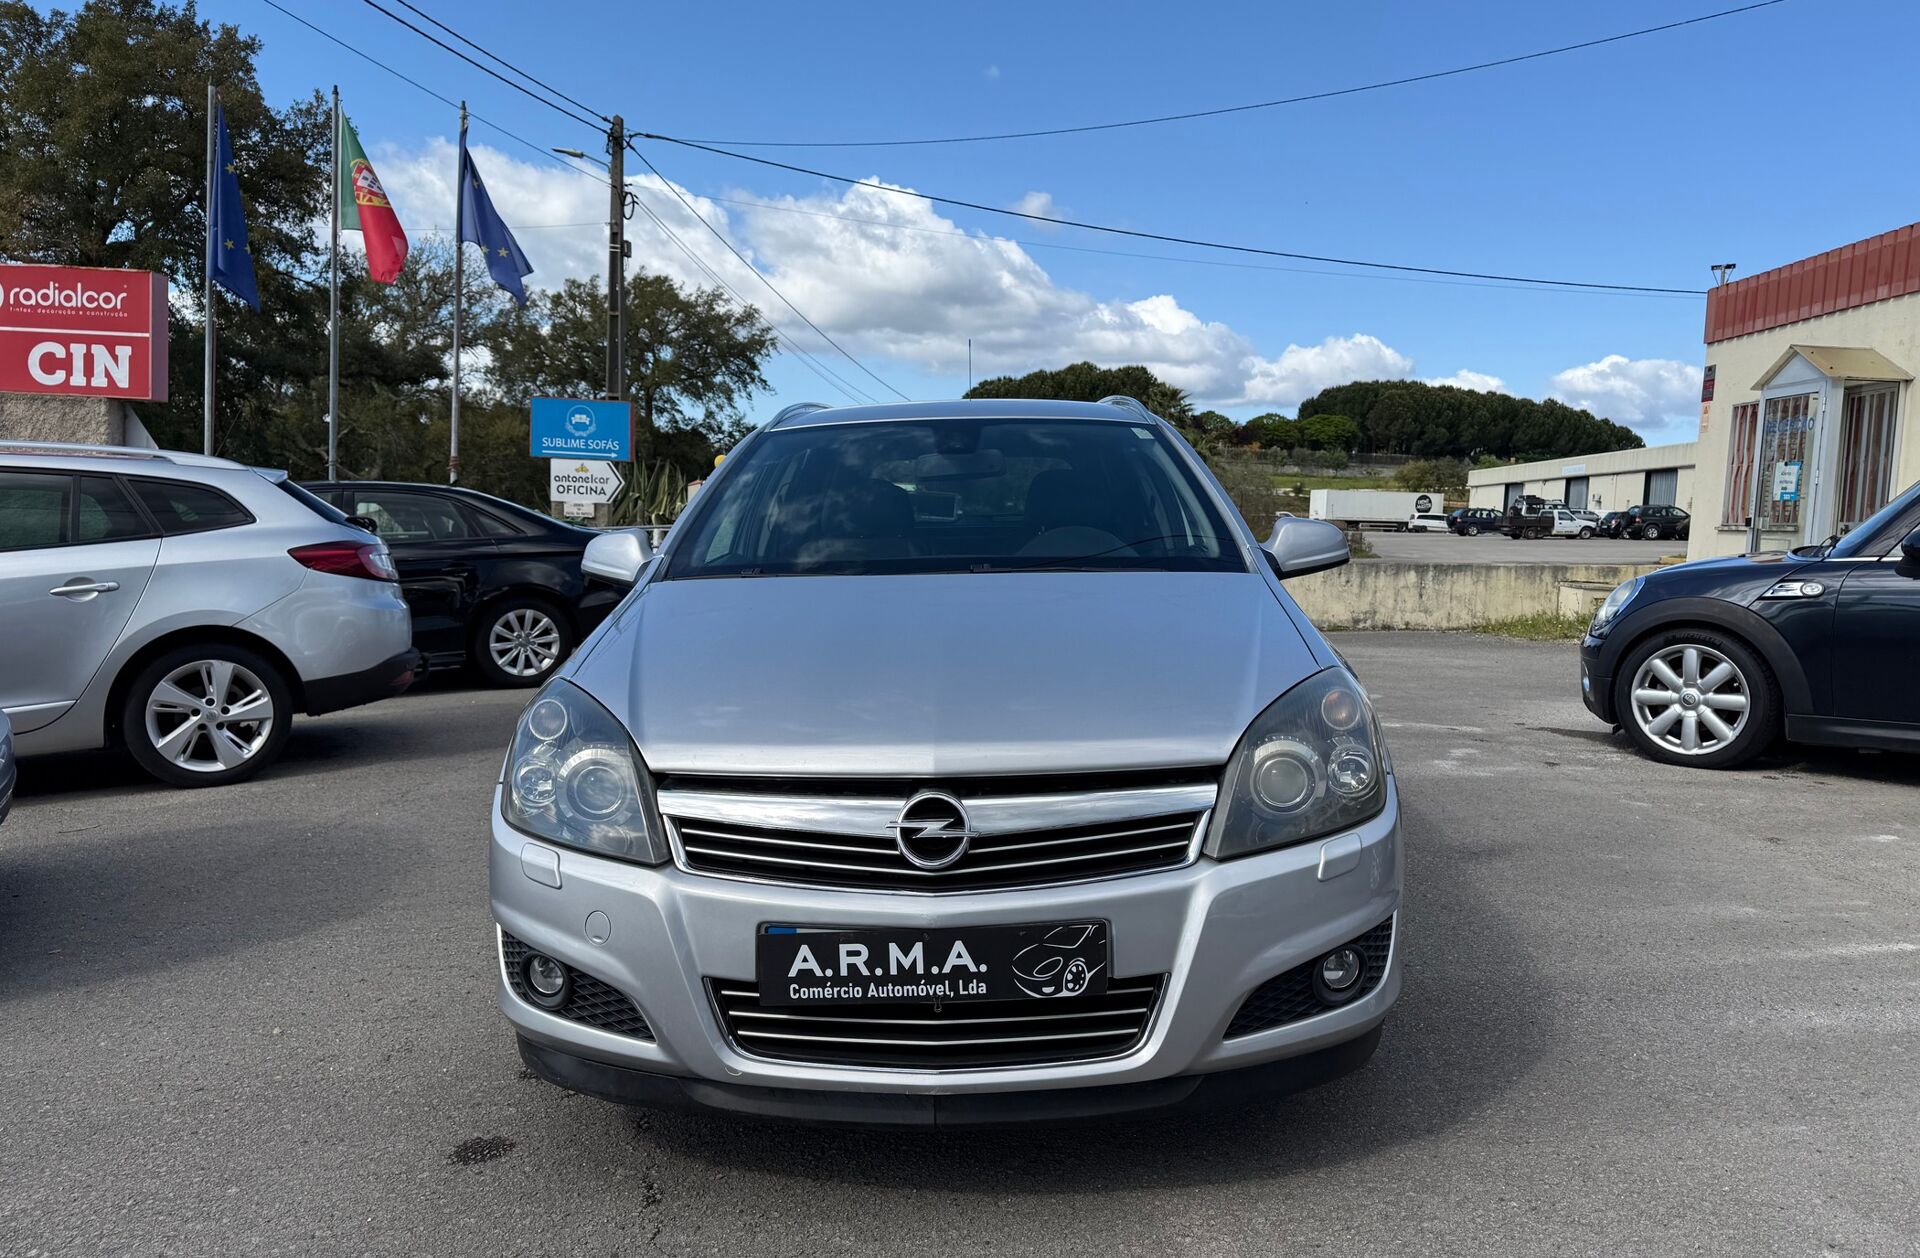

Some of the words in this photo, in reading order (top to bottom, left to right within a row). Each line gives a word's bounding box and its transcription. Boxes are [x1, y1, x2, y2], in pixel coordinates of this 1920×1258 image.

[10, 281, 127, 309] radialcor
[28, 341, 132, 388] CIN
[542, 437, 586, 449] SUBLIME
[587, 439, 620, 451] SOFÁS
[553, 474, 609, 485] antonelcar
[556, 484, 607, 496] OFICINA
[788, 940, 988, 977] A.R.M.A.
[789, 982, 863, 999] Comércio
[867, 979, 954, 998] Automóvel,
[959, 979, 987, 995] Lda
